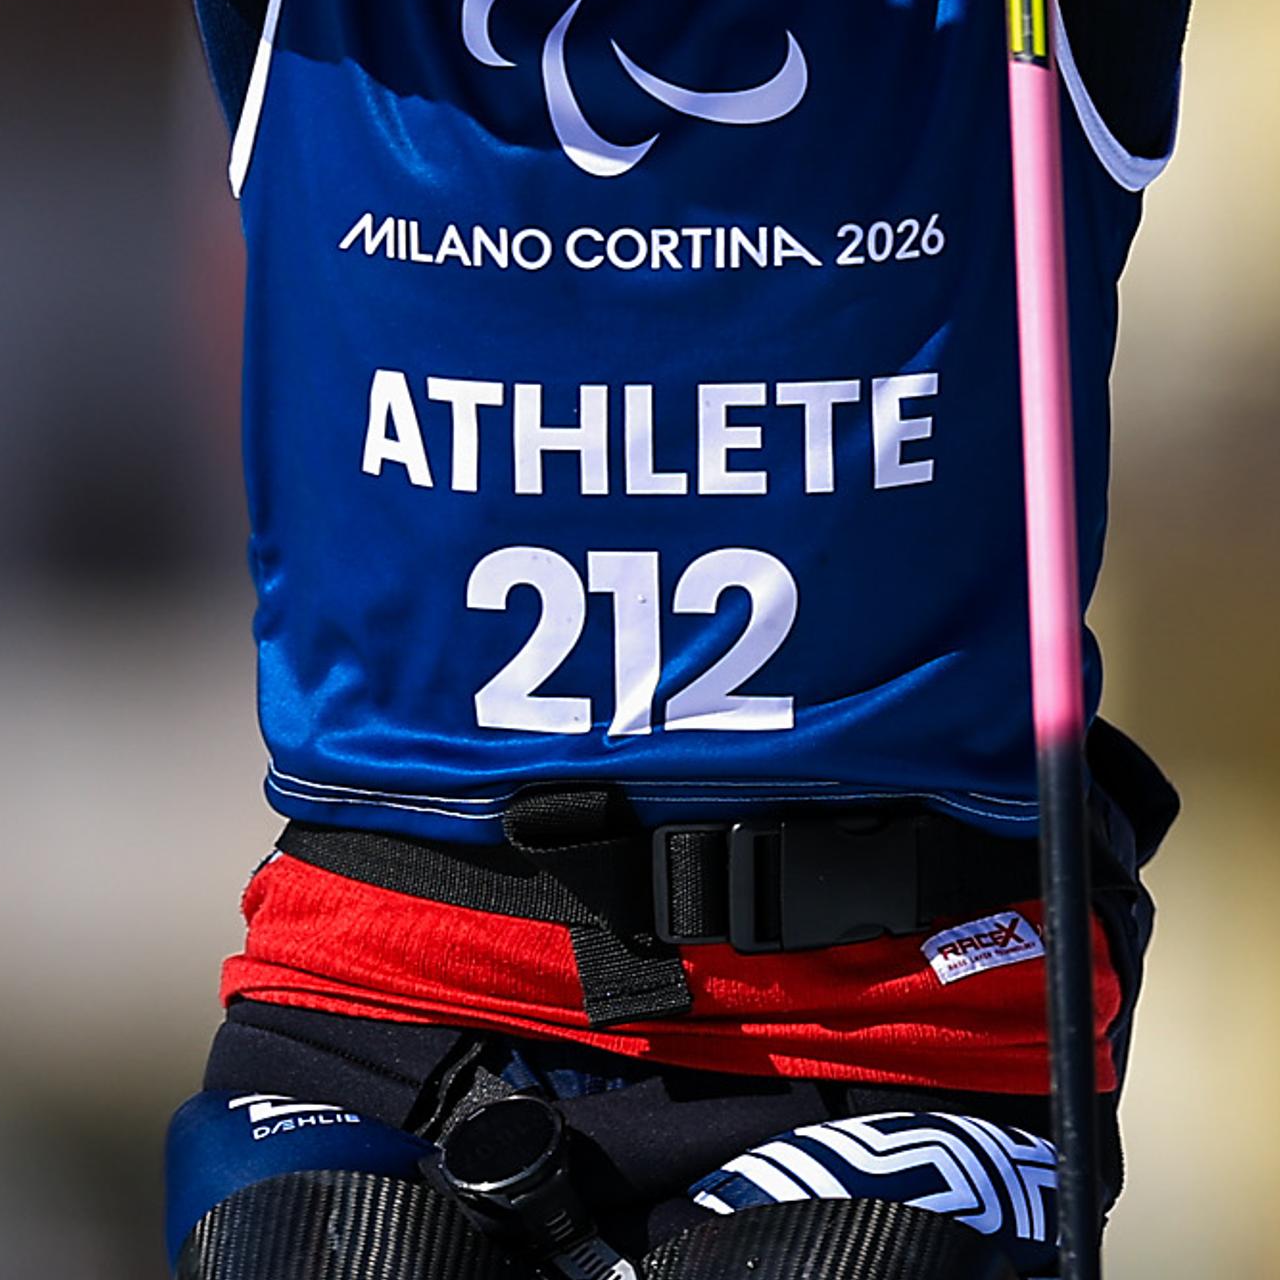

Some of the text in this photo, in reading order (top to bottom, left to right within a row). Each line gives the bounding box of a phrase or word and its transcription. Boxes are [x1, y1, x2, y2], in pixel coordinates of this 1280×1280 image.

[338, 212, 946, 270] MILANO CORTINA 2026
[361, 368, 939, 496] ATHLETE
[465, 546, 799, 737] 212
